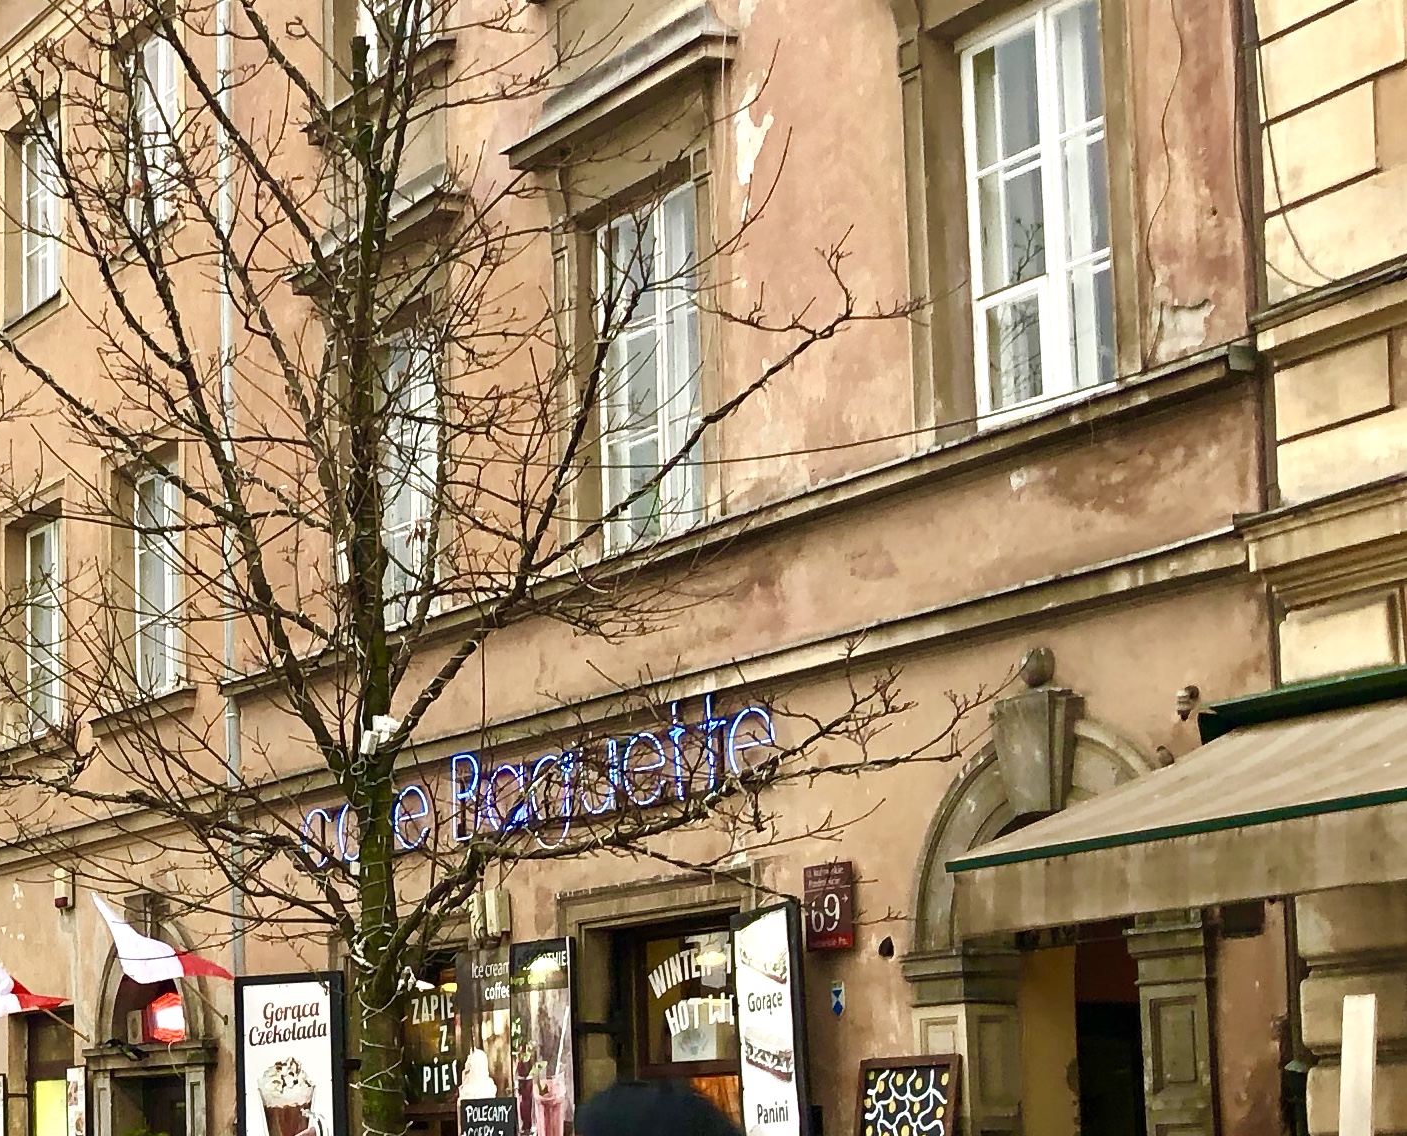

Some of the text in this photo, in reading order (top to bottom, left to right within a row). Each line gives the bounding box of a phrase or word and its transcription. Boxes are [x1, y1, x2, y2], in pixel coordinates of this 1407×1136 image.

[450, 694, 777, 849] Baguette
[811, 893, 840, 932] 69
[471, 962, 483, 979] Ice
[262, 1002, 320, 1029] Gorąca
[747, 991, 783, 1015] Gorące
[664, 997, 701, 1038] HOT
[249, 1019, 327, 1047] Czekolada
[465, 1104, 513, 1123] POLECAMY
[756, 1100, 789, 1125] Panini
